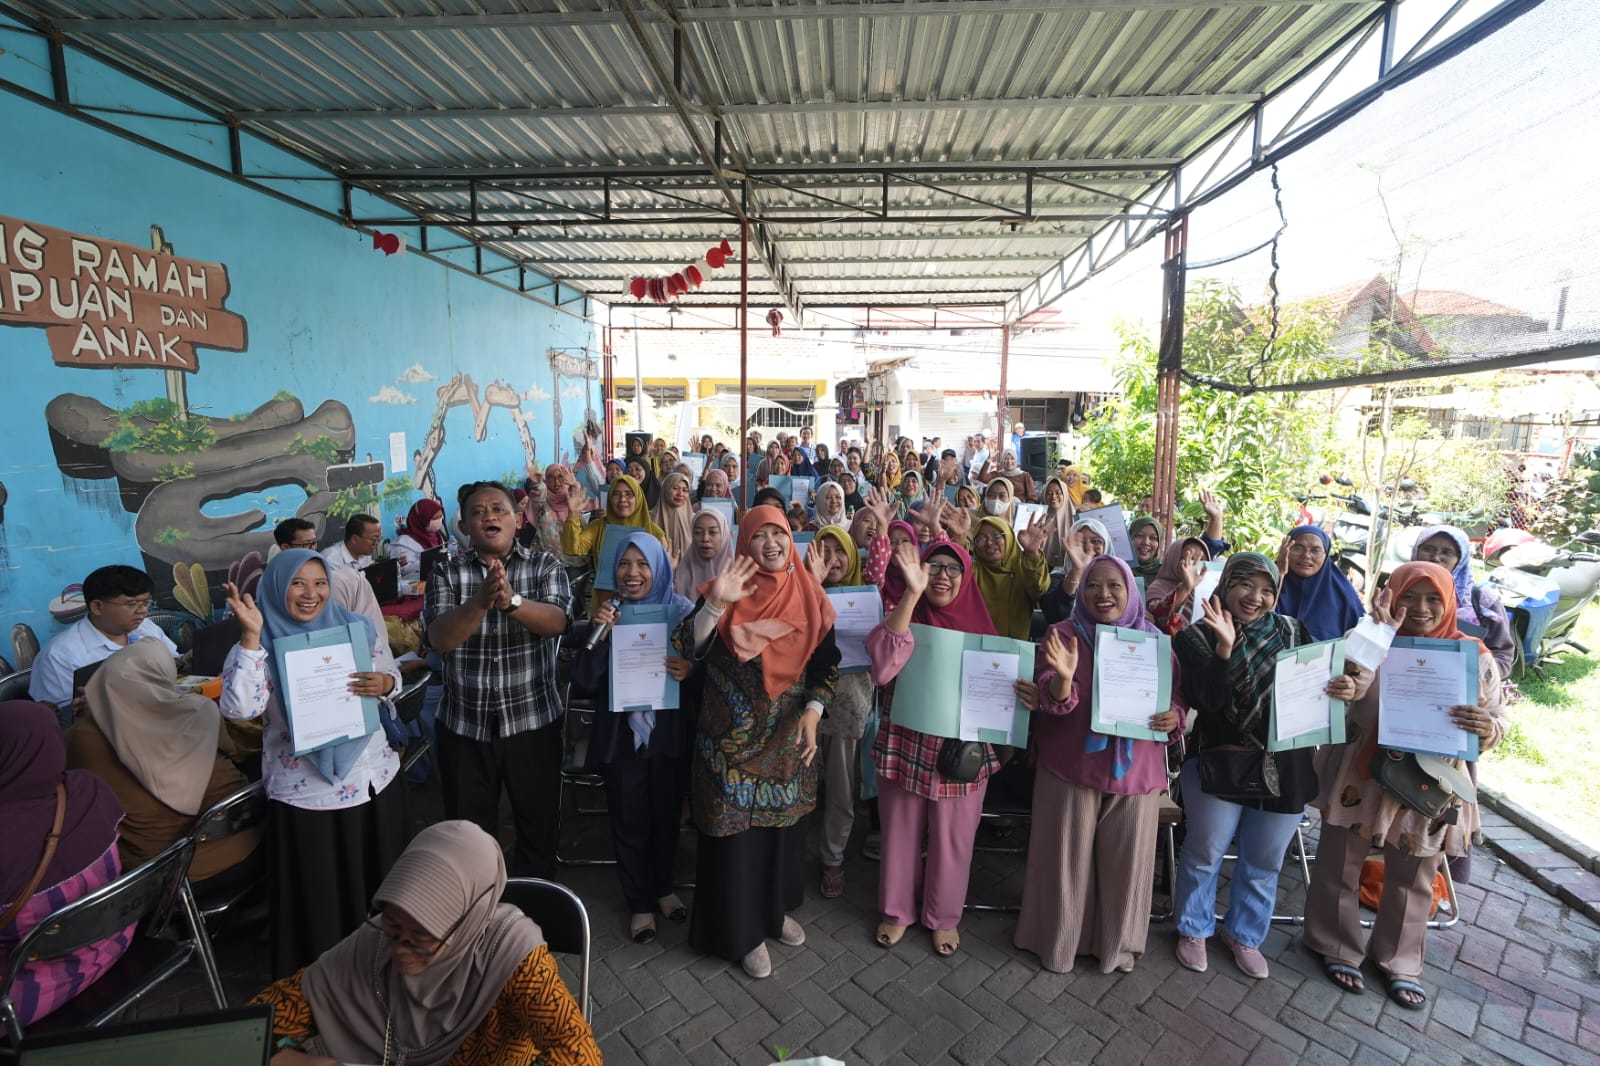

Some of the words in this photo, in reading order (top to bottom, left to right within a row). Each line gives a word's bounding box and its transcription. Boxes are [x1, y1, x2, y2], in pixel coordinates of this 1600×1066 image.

[72, 238, 207, 299] RAMAH
[0, 271, 132, 322] PUAN
[160, 305, 207, 330] DAN
[72, 323, 188, 365] ANAK
